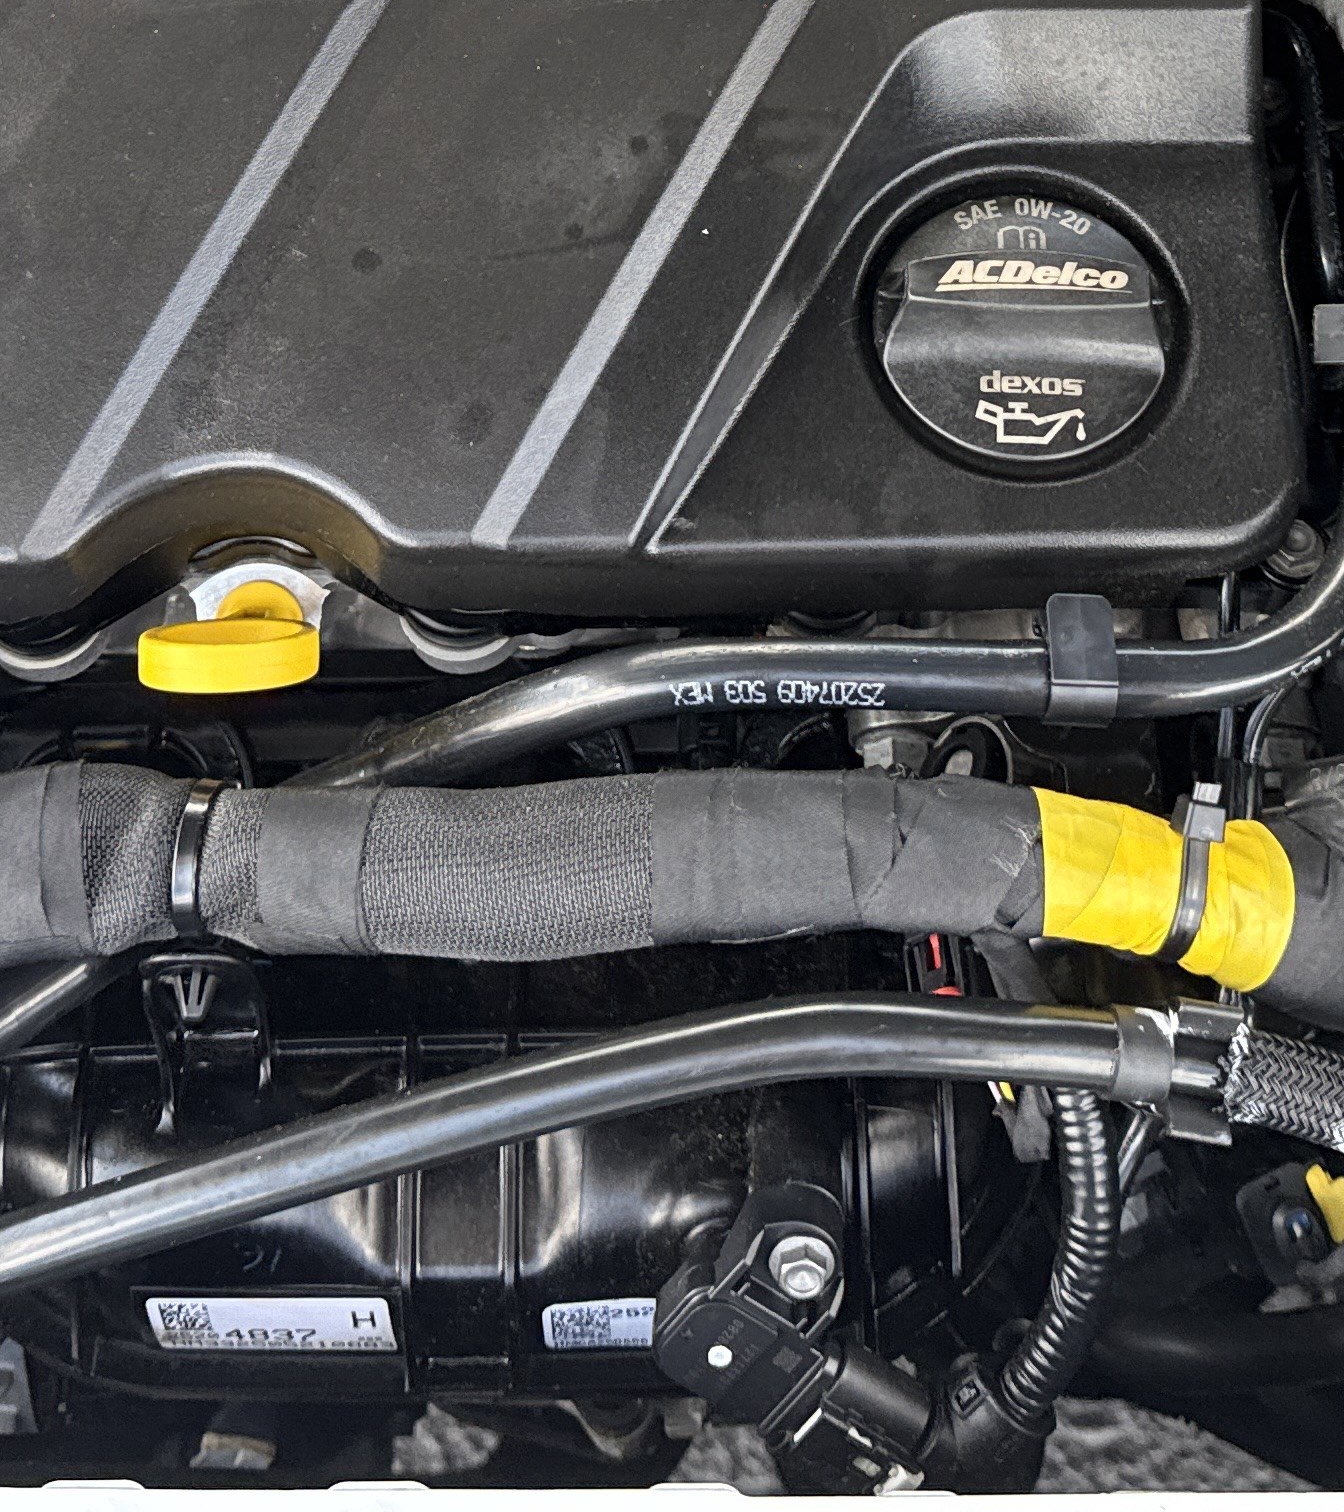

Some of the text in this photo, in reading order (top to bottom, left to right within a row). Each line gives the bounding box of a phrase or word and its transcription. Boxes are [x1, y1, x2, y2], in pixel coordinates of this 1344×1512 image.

[953, 197, 1092, 236] SAE 0W-20
[937, 260, 1130, 291] ACDelco
[979, 370, 1086, 396] dexos
[668, 679, 887, 707] 25207409 503 MEX
